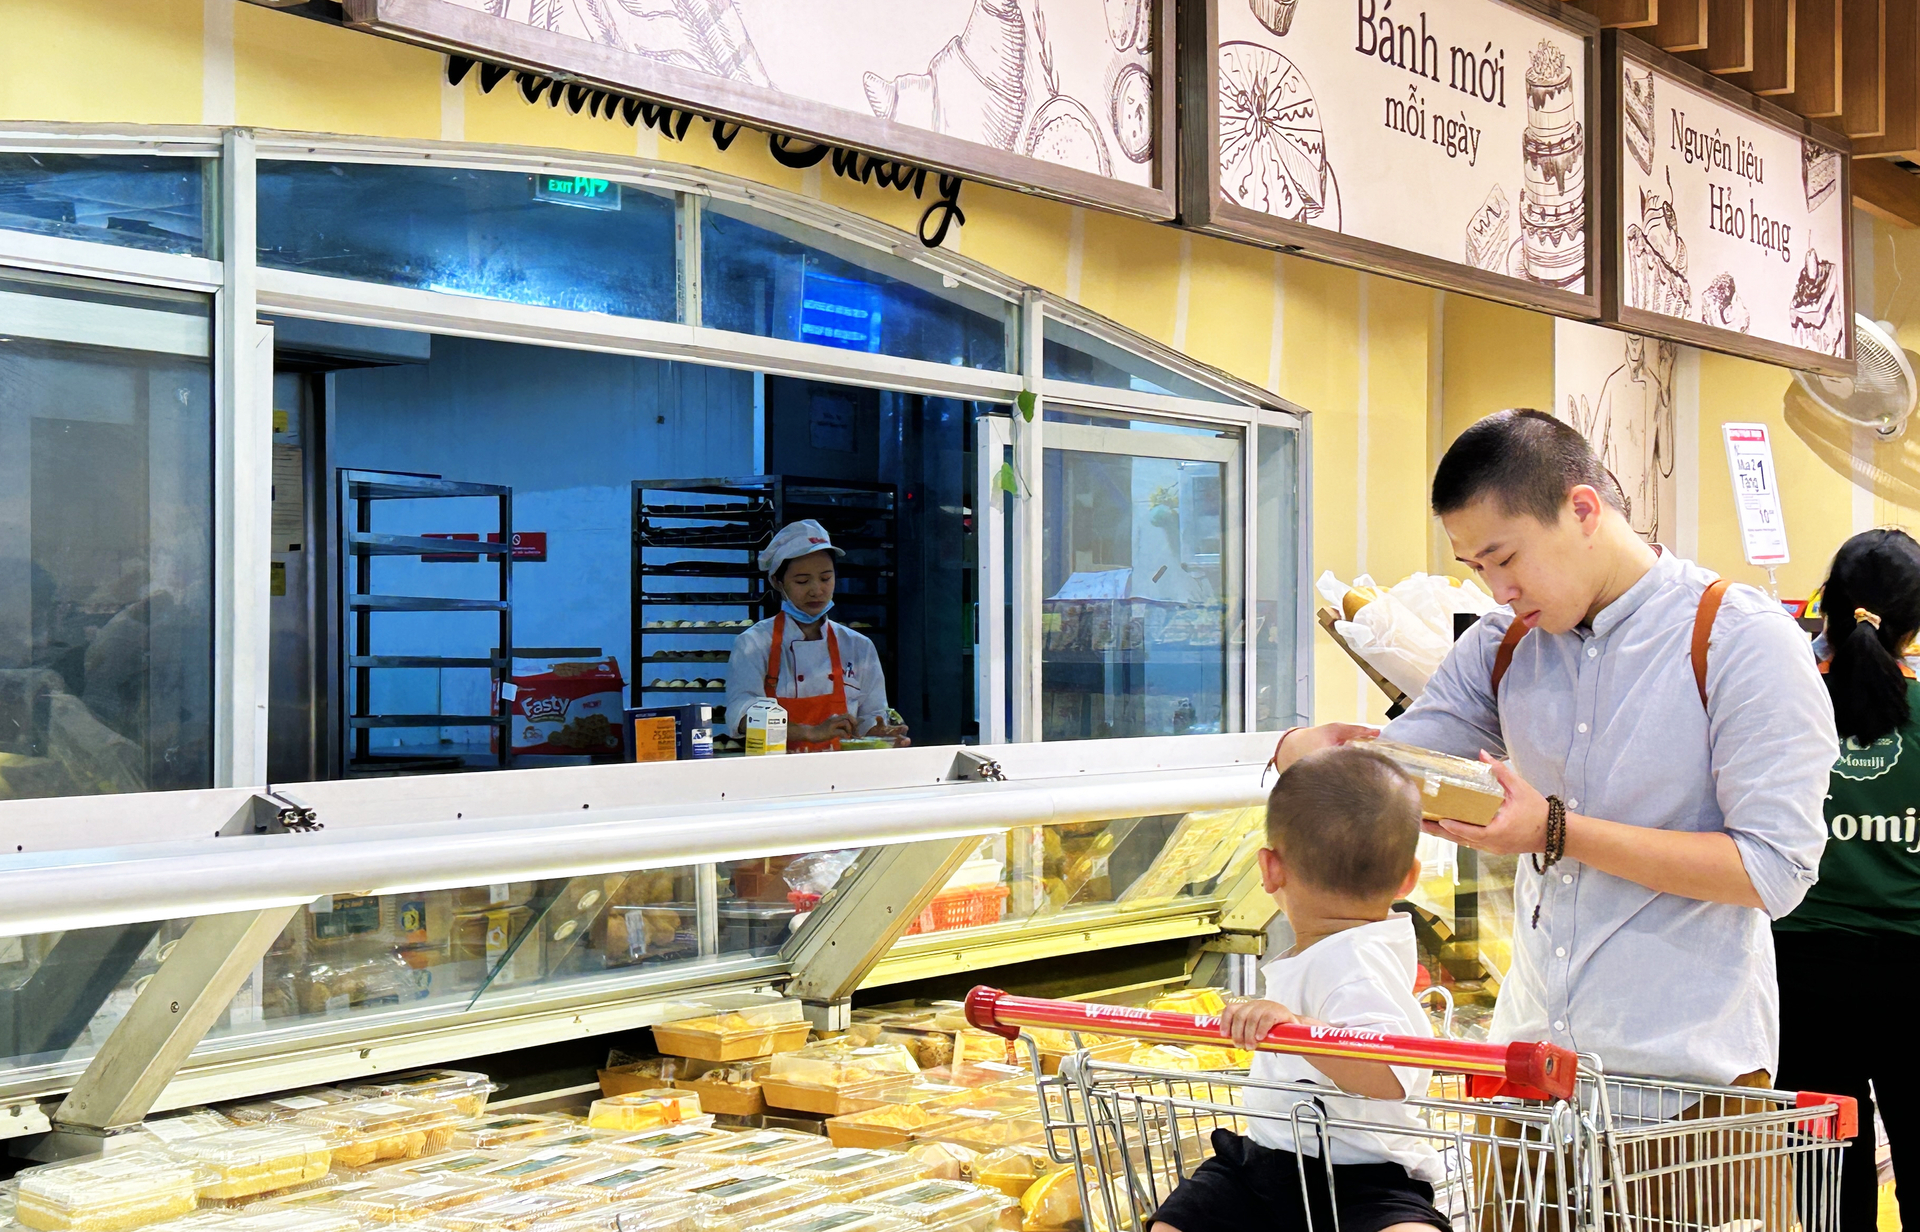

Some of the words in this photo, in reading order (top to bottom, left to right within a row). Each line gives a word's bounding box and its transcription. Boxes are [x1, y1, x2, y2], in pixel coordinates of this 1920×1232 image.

[1355, 0, 1440, 82] Bánh
[1449, 41, 1506, 108] mới
[1385, 84, 1426, 139] mỗi
[1432, 111, 1481, 167] ngày
[1670, 108, 1732, 173] Nguyên
[1736, 136, 1764, 187] liệu
[548, 179, 573, 194] EXIT
[1709, 184, 1745, 239] Hảo
[1750, 198, 1791, 263] hạng
[521, 696, 570, 717] Fasty
[1837, 754, 1884, 769] Momiji
[1085, 1003, 1152, 1019] WinMart
[1310, 1026, 1385, 1041] WinMart
